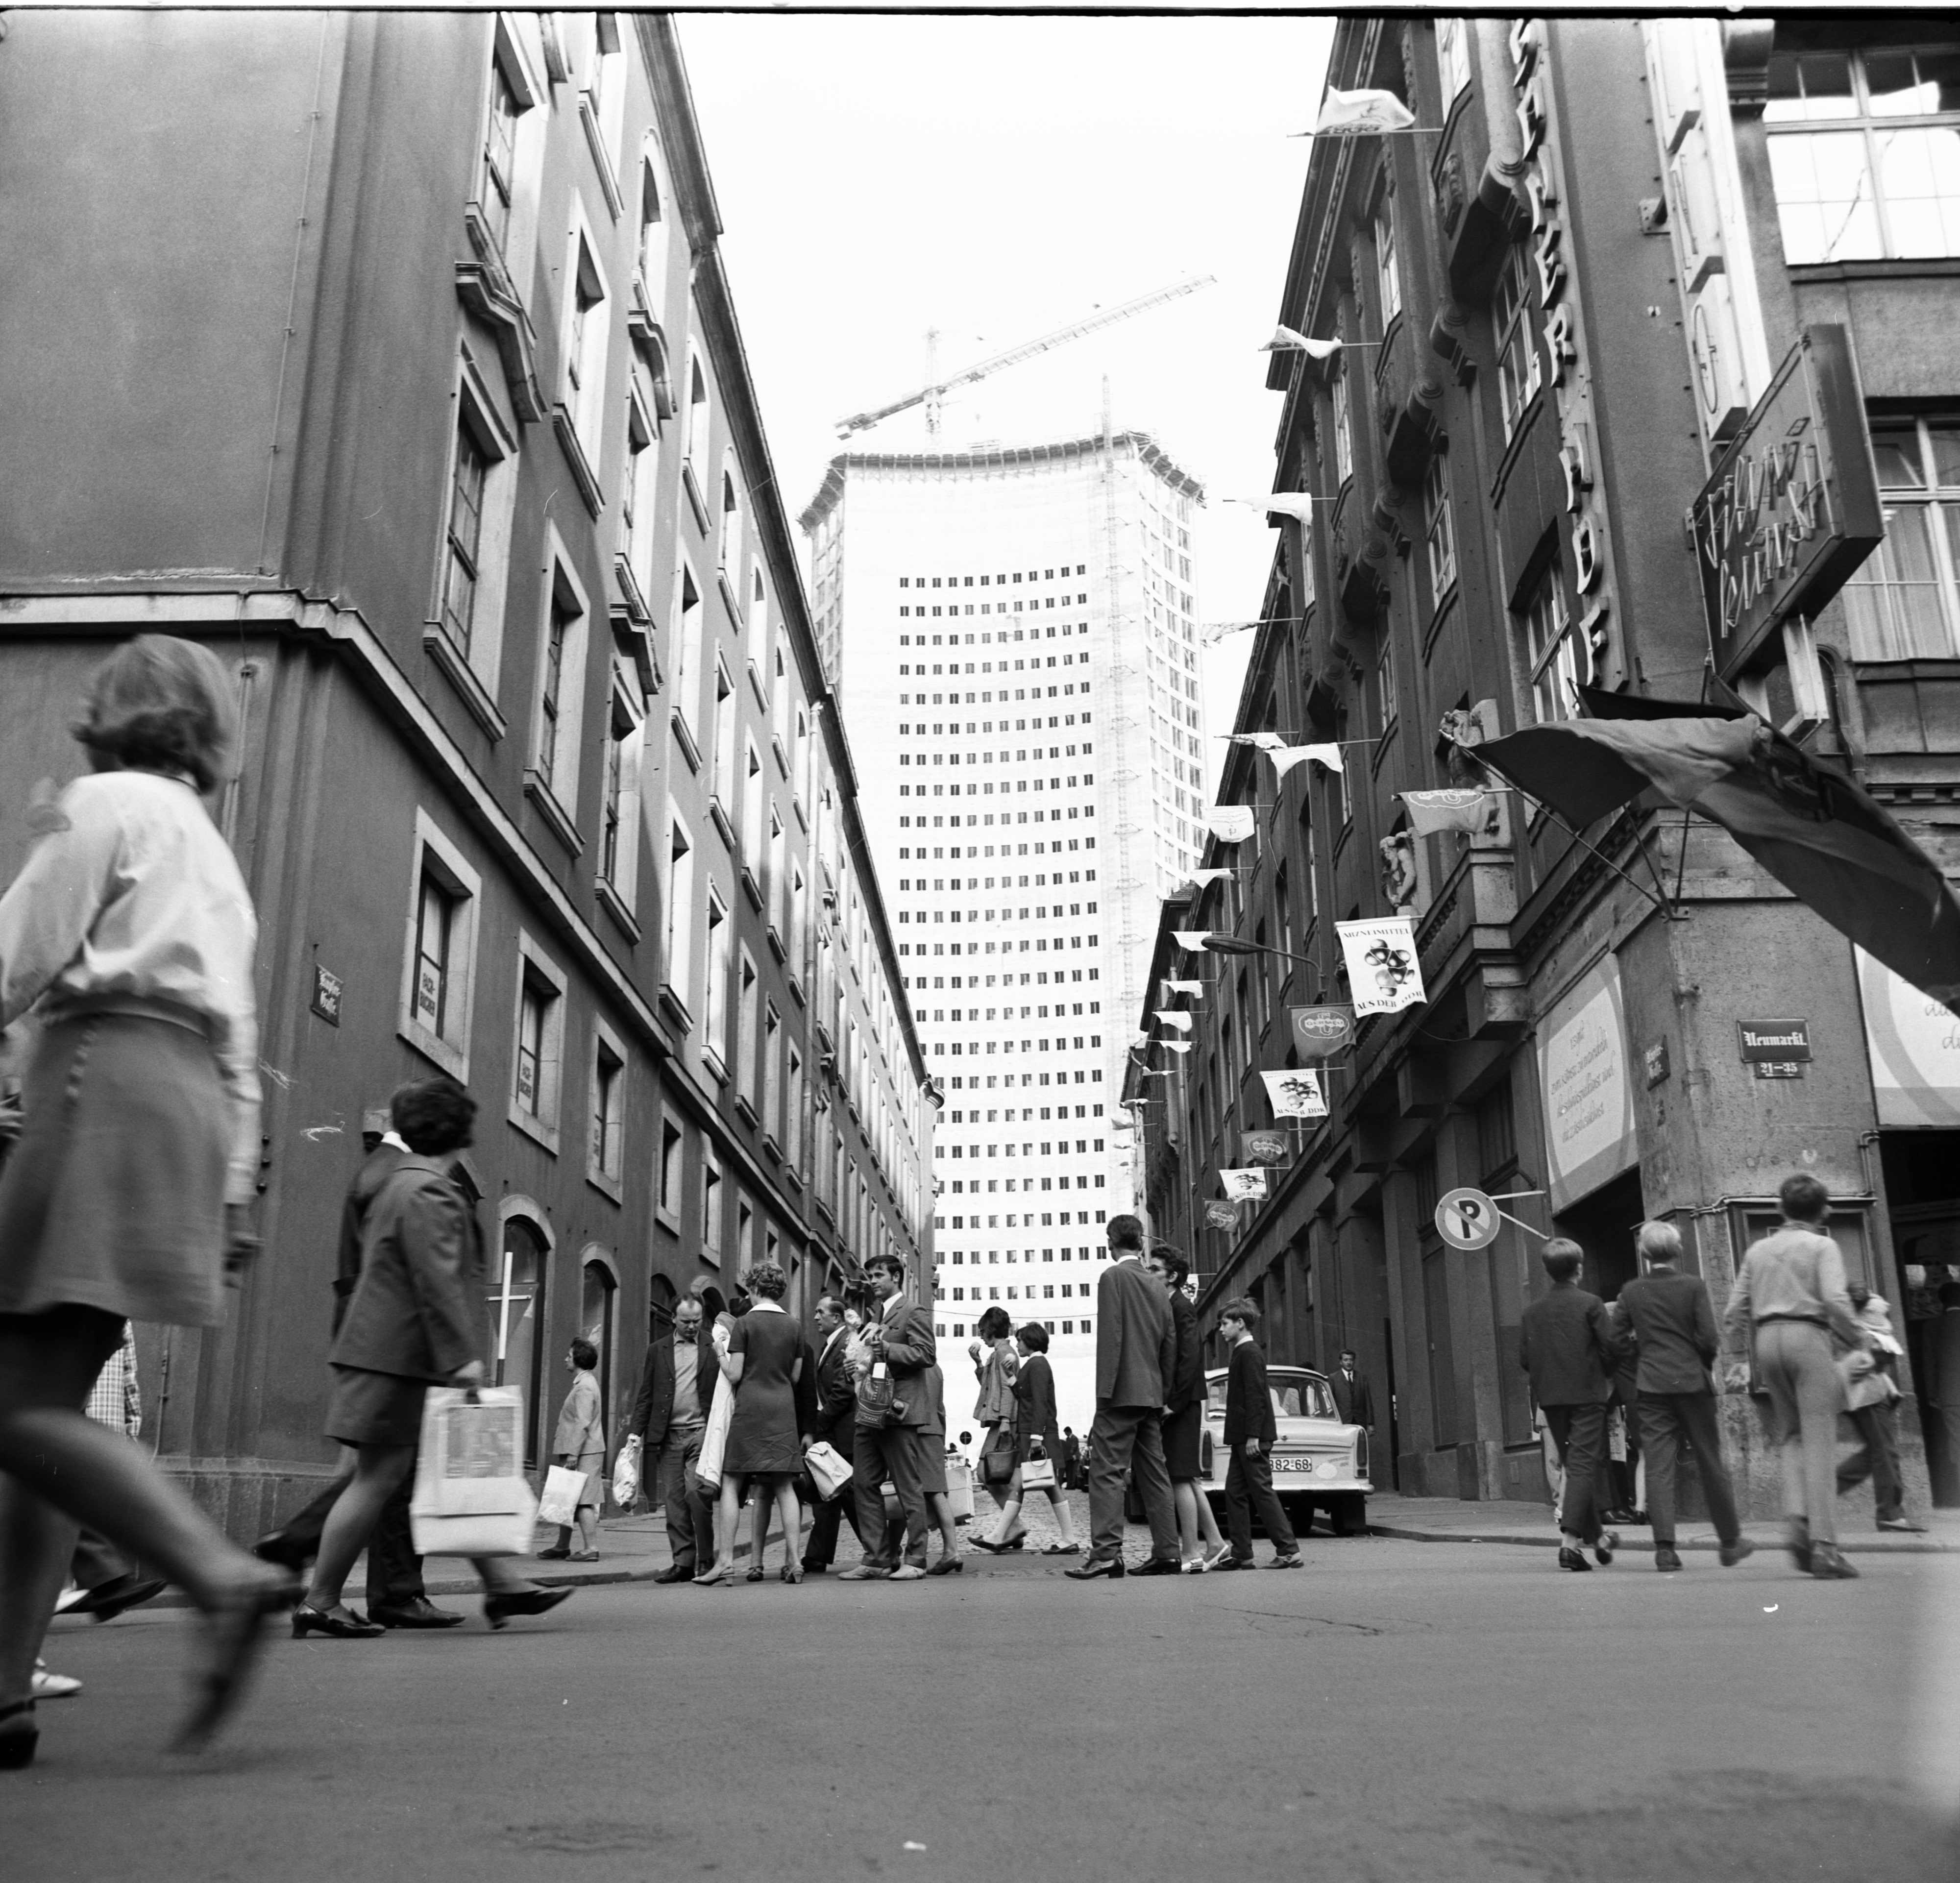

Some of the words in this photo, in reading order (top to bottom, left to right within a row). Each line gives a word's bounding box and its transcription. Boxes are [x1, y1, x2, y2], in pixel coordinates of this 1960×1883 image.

[1343, 928, 1410, 938] ARZNEIMITTEL
[1357, 1000, 1375, 1010] AUS
[1458, 1200, 1480, 1239] P
